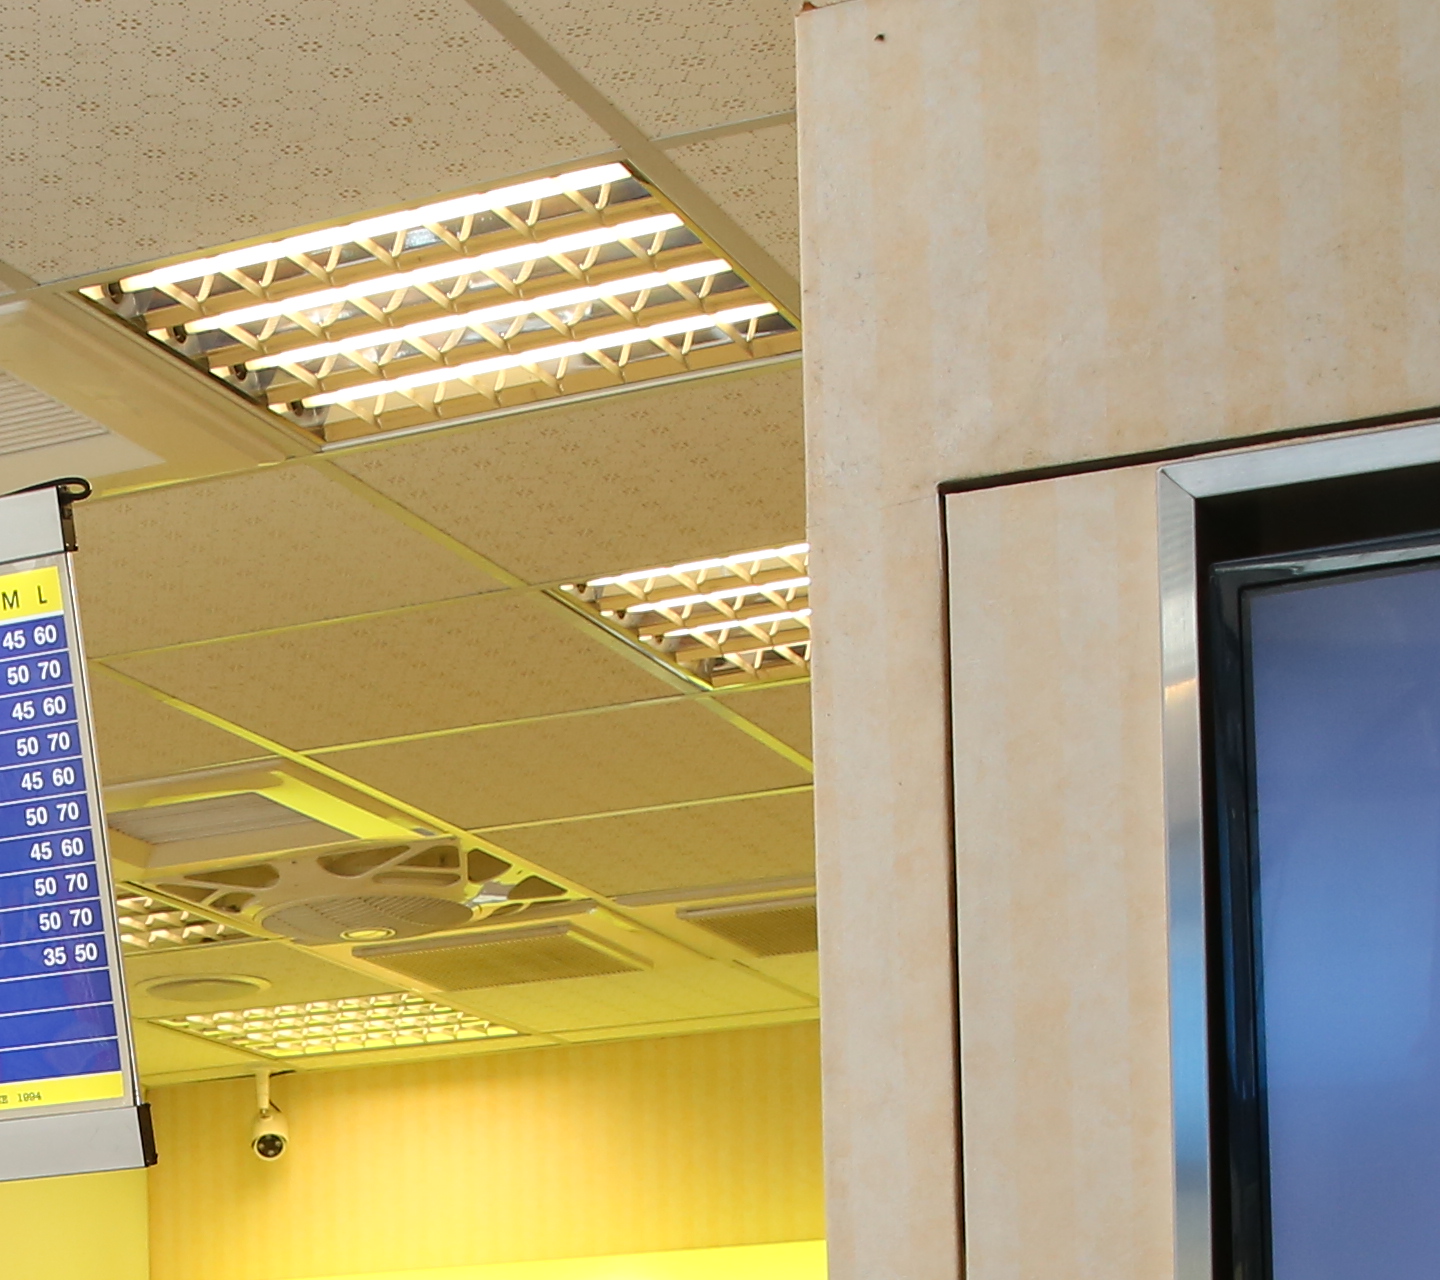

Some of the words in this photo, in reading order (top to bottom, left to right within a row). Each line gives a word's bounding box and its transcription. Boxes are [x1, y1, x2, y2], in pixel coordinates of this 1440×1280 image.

[1, 591, 20, 610] M
[38, 585, 47, 604] L
[3, 630, 25, 650] 45
[34, 625, 57, 644] 60
[7, 665, 29, 685] 50
[38, 660, 61, 680] 70
[12, 701, 35, 721] 45
[43, 696, 66, 716] 60
[16, 736, 38, 756] 50
[47, 731, 70, 751] 70
[21, 771, 43, 790] 45
[52, 766, 75, 786] 60
[26, 806, 47, 826] 50
[56, 802, 79, 821] 70
[31, 842, 52, 861] 45
[61, 838, 83, 856] 60
[35, 877, 56, 896] 50
[66, 873, 88, 891] 70
[39, 912, 61, 931] 50
[70, 908, 93, 926] 70
[43, 947, 66, 966] 35
[75, 943, 97, 962] 50
[18, 1092, 41, 1102] 1994
